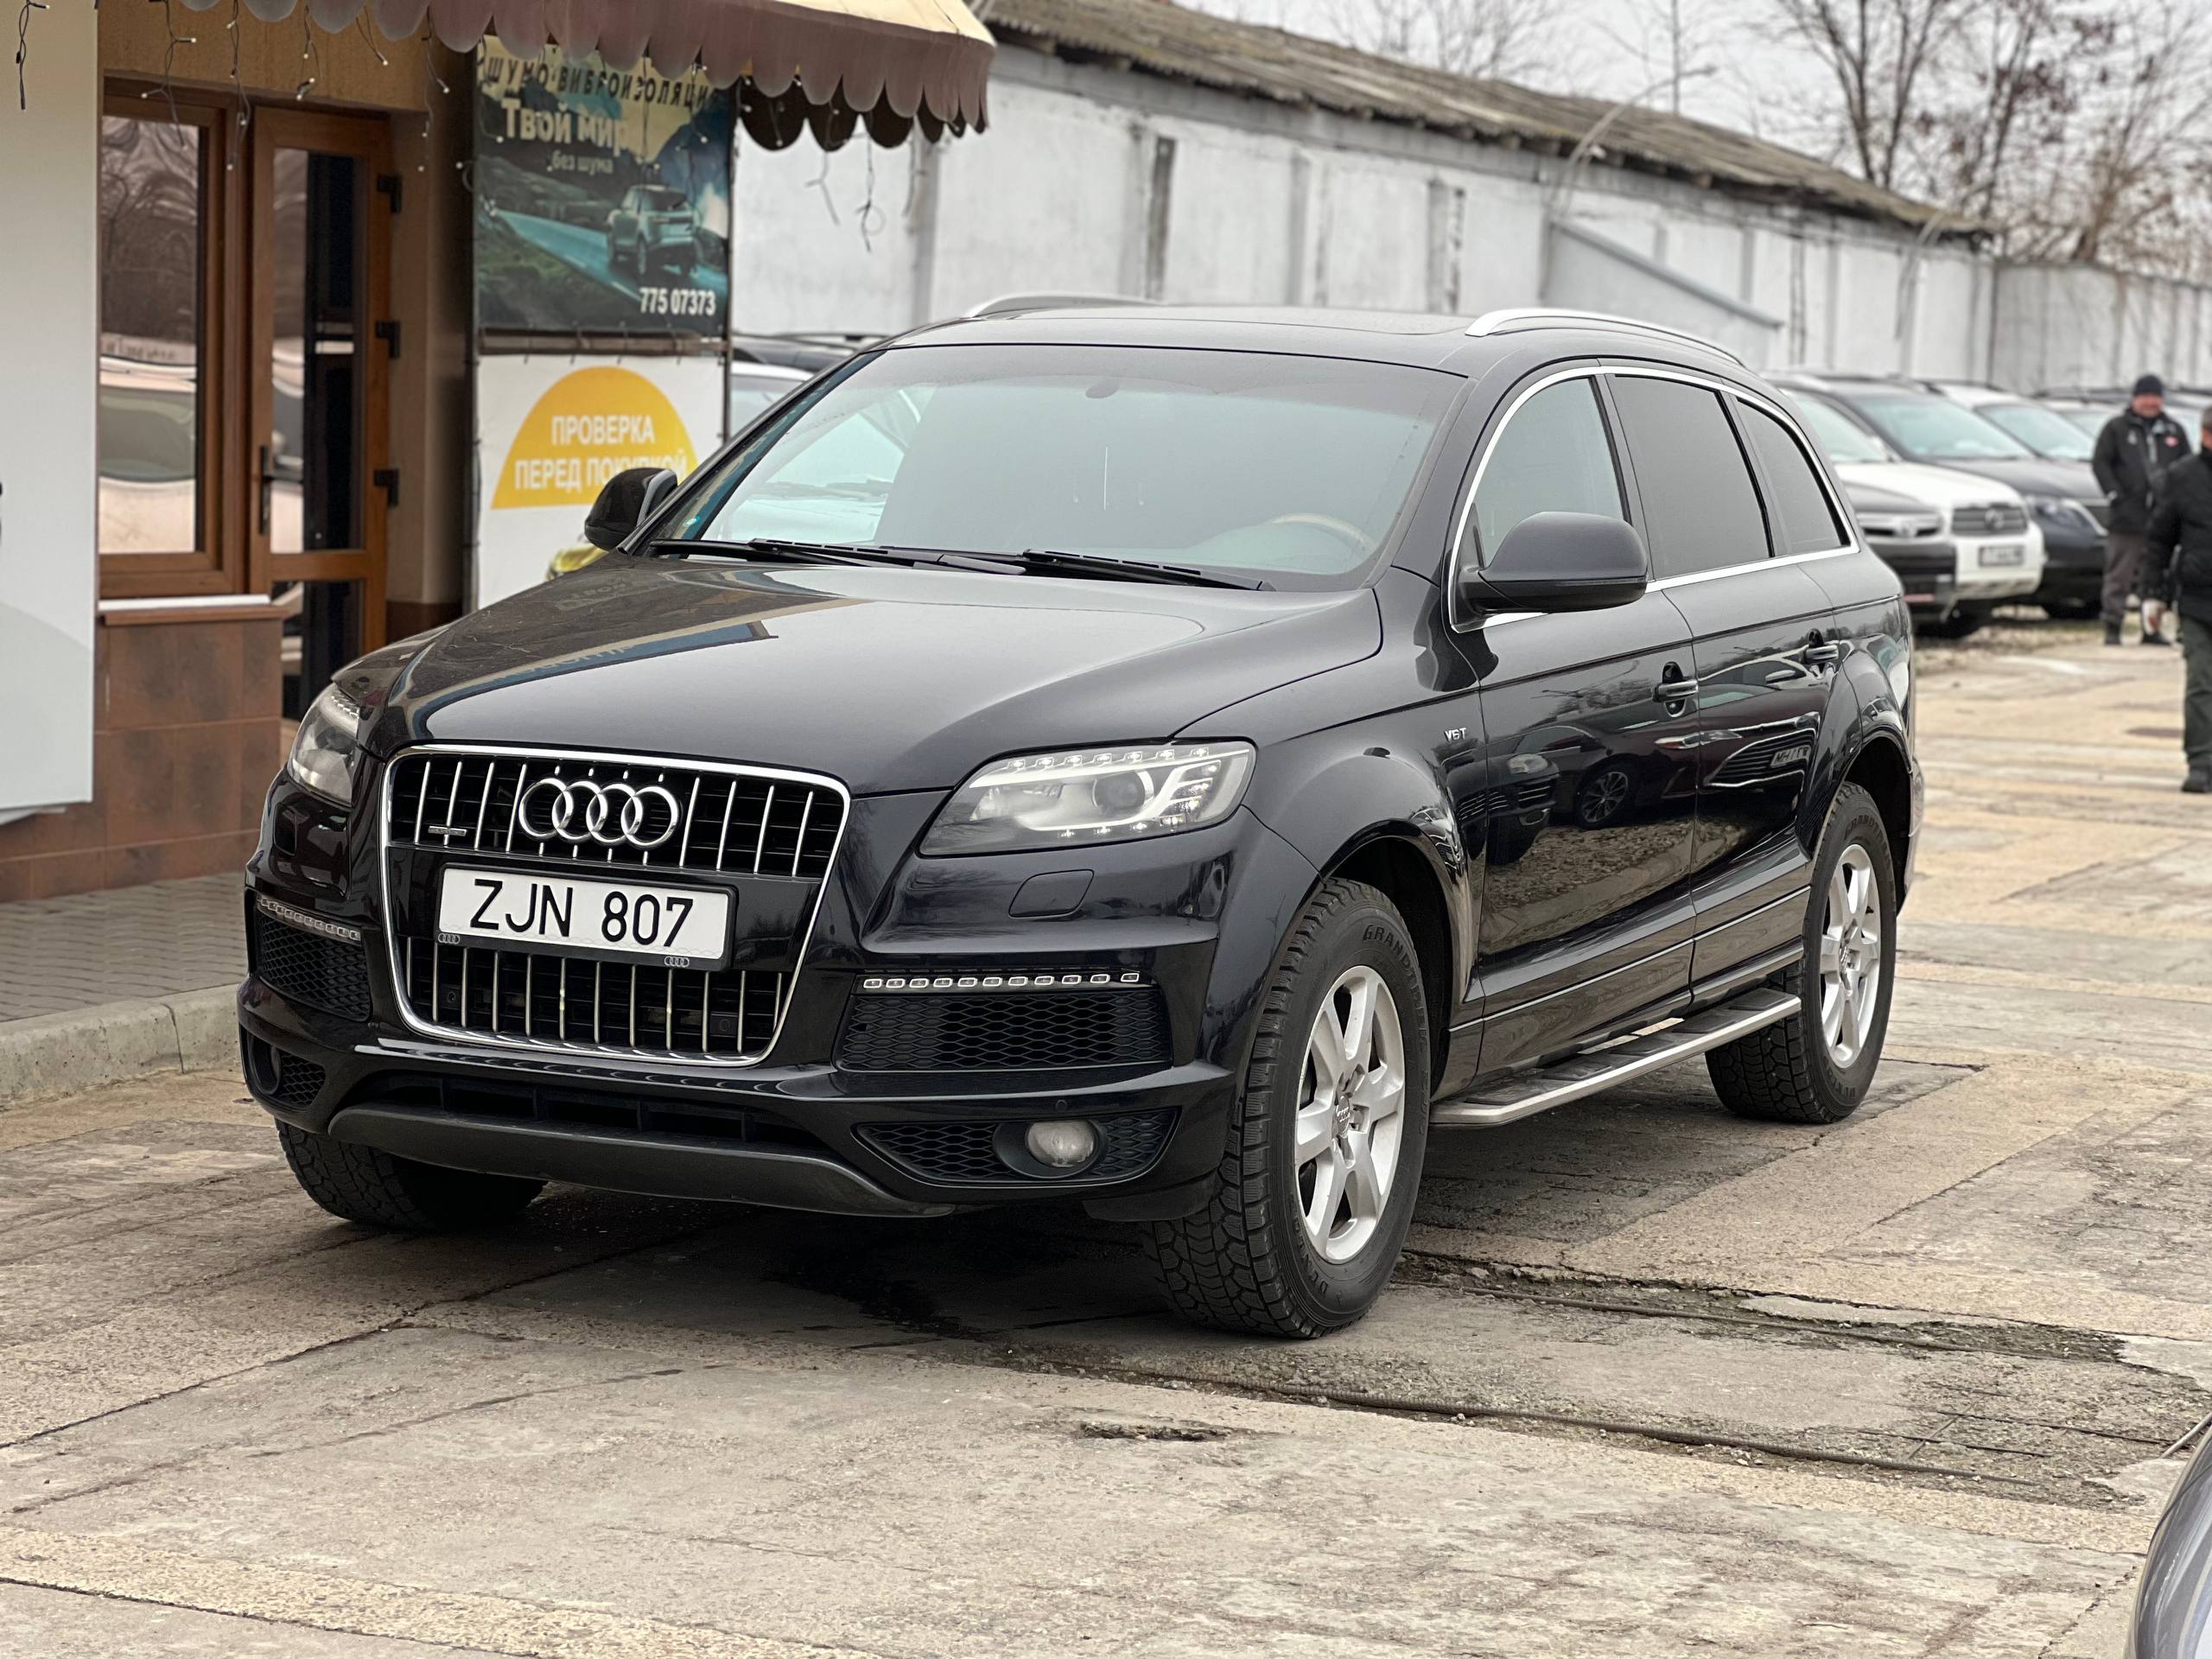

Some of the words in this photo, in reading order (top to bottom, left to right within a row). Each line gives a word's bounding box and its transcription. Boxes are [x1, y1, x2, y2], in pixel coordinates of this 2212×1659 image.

[639, 287, 669, 315] 775
[671, 288, 716, 316] 07373
[551, 414, 656, 446] ПРОВЕРКА
[514, 456, 582, 494] ПЕРЕД
[1444, 727, 1467, 741] V6T
[469, 878, 574, 938] ZJN
[601, 891, 694, 947] 807
